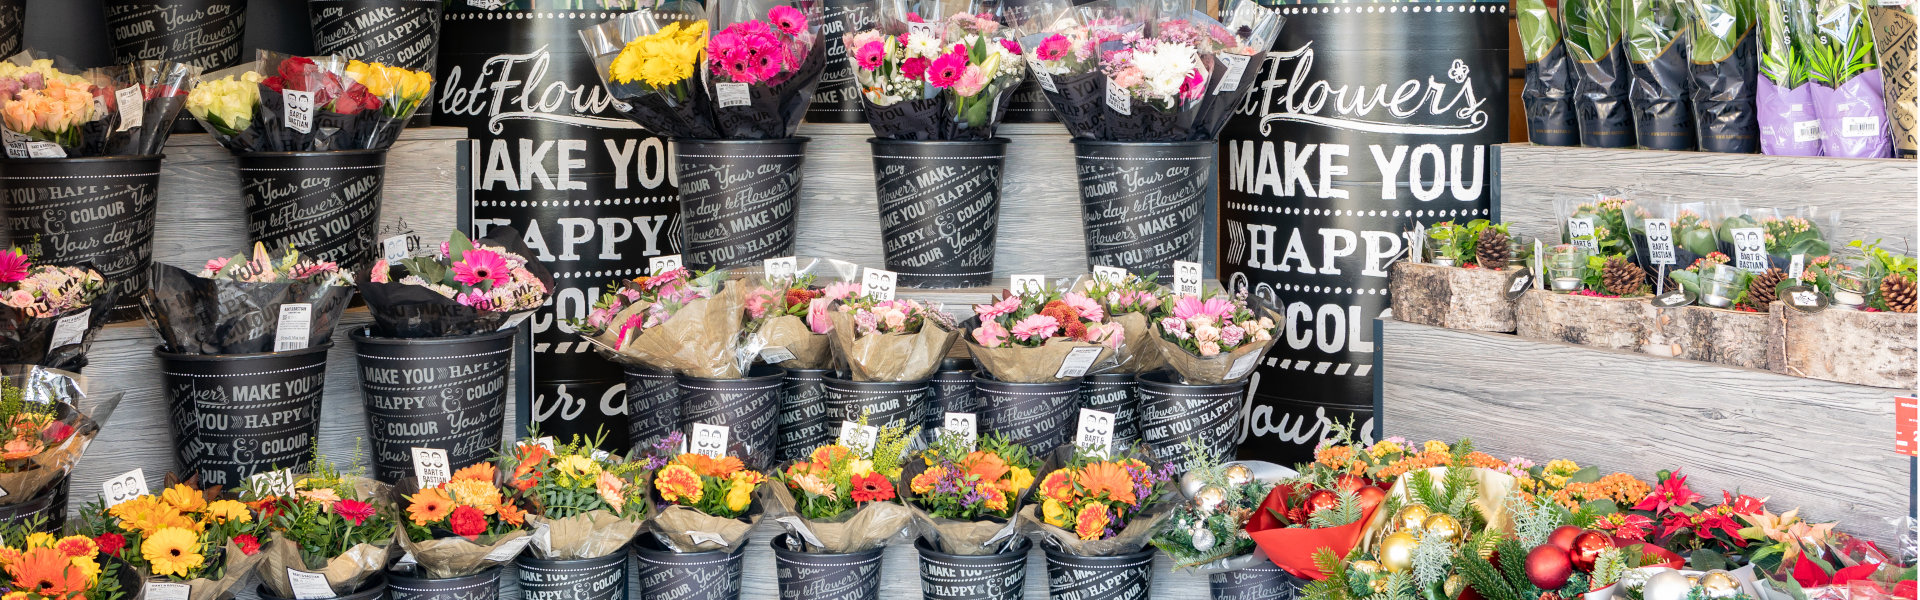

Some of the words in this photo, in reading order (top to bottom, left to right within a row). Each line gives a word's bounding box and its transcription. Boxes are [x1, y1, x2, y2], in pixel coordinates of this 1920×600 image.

[115, 20, 155, 41] COLOUR
[160, 8, 204, 31] Your
[374, 16, 421, 48] HAPPY
[220, 45, 239, 63] YOU
[397, 34, 432, 63] COLOUR
[1883, 51, 1902, 83] AKE
[839, 86, 858, 101] YO
[288, 116, 309, 129] BASTIAN
[289, 110, 301, 119] BART
[9, 148, 29, 157] BASTI
[715, 167, 754, 190] Your
[1229, 139, 1349, 199] MAKE
[1369, 143, 1485, 201] YOU
[258, 181, 299, 206] Your
[1085, 181, 1118, 198] COLOUR
[1123, 171, 1164, 193] Your
[697, 198, 721, 217] day
[899, 201, 926, 222] YOU
[934, 175, 982, 207] HAPPY
[1103, 201, 1129, 219] day
[42, 208, 67, 235] &
[70, 201, 126, 225] COLOUR
[320, 214, 351, 238] YOU
[730, 210, 770, 233] MAKE
[771, 200, 791, 220] YOU
[887, 227, 924, 253] HAPPY
[935, 212, 955, 237] &
[957, 192, 993, 222] COLOUR
[1138, 213, 1178, 236] MAKE
[1178, 202, 1198, 223] YOU
[51, 233, 100, 258] Your
[103, 223, 135, 245] day
[708, 245, 735, 263] YOU
[745, 225, 789, 253] HAPPY
[947, 229, 982, 254] Your
[1115, 248, 1143, 266] YOU
[1154, 228, 1195, 257] HAPPY
[1247, 223, 1403, 278] HAPP
[1652, 243, 1664, 251] BART
[1652, 251, 1673, 259] BASTIAN
[1739, 260, 1764, 270] BASTIAN
[1740, 252, 1754, 261] BART
[1755, 253, 1760, 261] &
[1286, 301, 1374, 353] COL
[365, 366, 399, 384] MAKE
[402, 367, 434, 384] YOU
[232, 383, 281, 402] MAKE
[285, 376, 311, 397] YOU
[374, 395, 426, 410] HAPPY
[440, 388, 464, 413] &
[466, 376, 504, 401] COLOUR
[655, 387, 679, 404] HAP
[1091, 390, 1127, 406] COLOUR
[734, 391, 771, 419] HAPPY
[802, 402, 826, 418] YOU
[197, 413, 228, 430] YOU
[244, 407, 303, 429] HAPPY
[388, 421, 439, 436] COLOUR
[447, 411, 487, 435] Your
[1033, 418, 1055, 434] YOU
[1146, 425, 1169, 441] MAKE
[1169, 418, 1192, 437] YOU
[1199, 397, 1234, 424] HAPPY
[786, 422, 824, 443] HAPPY
[1085, 434, 1100, 444] BART
[232, 438, 259, 465] &
[261, 433, 308, 455] COLOUR
[525, 589, 562, 600] HAPPY
[592, 568, 622, 592] COLOUR
[645, 568, 674, 588] HAPPY
[693, 564, 725, 588] Your
[935, 585, 976, 596] HAPPY
[986, 578, 1003, 597] &
[1087, 569, 1130, 597] HAPPY
